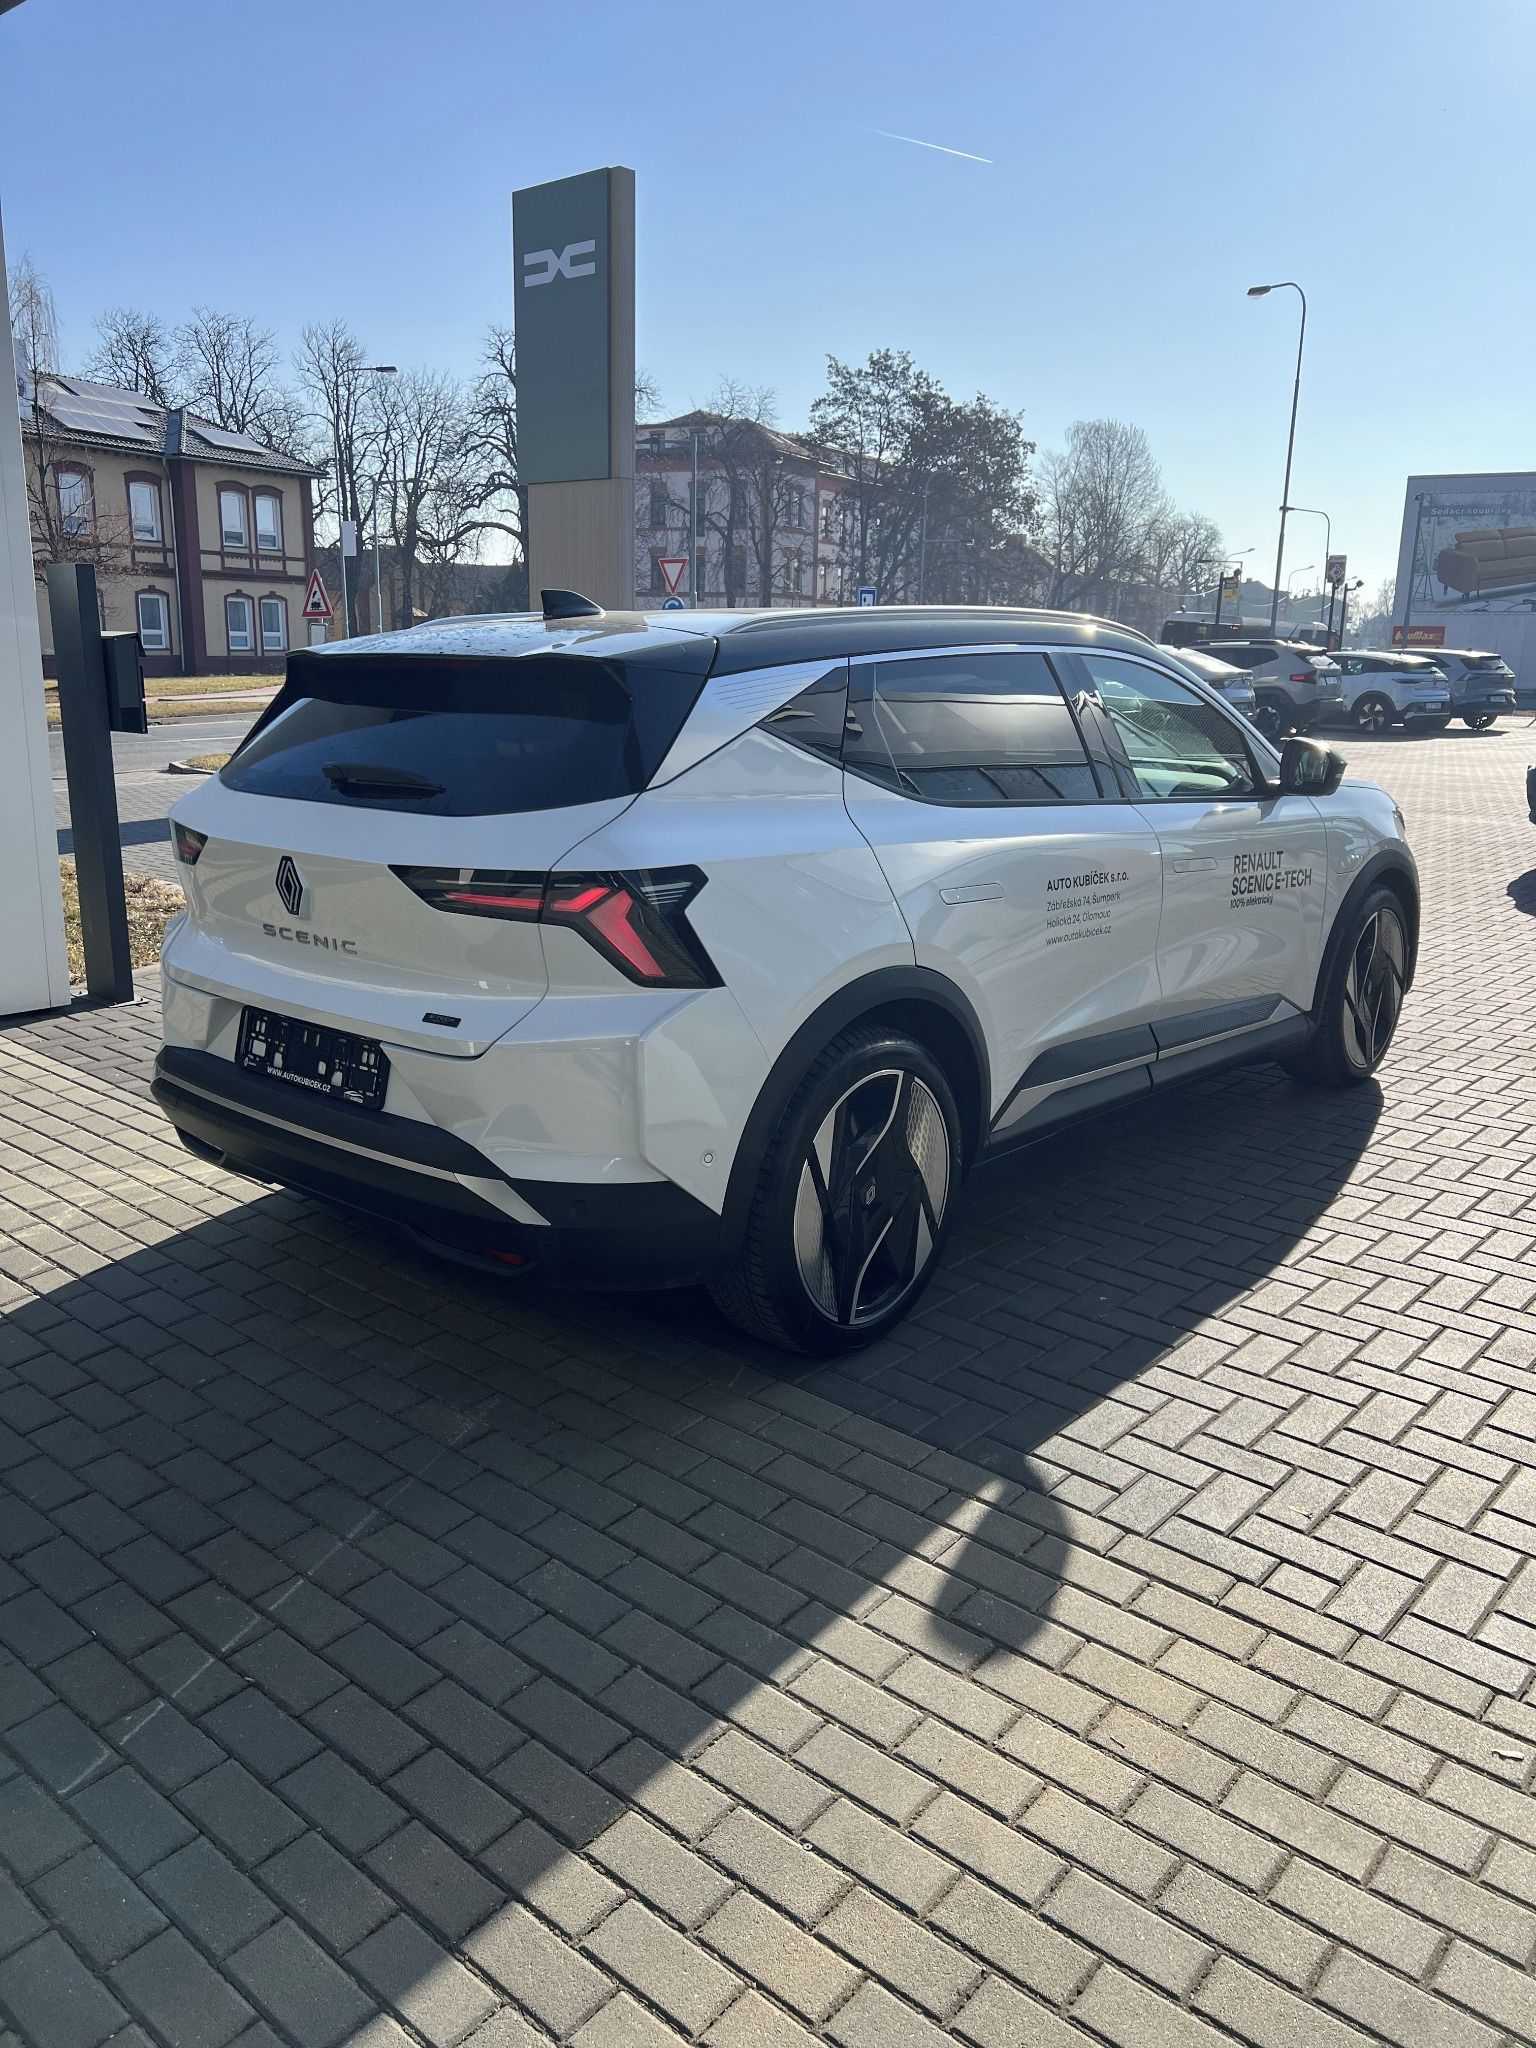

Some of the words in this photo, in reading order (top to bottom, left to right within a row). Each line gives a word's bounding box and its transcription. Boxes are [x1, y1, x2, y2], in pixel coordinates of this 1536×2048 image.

[1233, 851, 1284, 874] RENAULT
[1046, 877, 1072, 892] AUTO
[1072, 870, 1110, 888] KUBÍČEK
[1110, 871, 1129, 882] s.r.o.
[1231, 872, 1274, 896] SCENIC
[1274, 868, 1312, 890] E-TECH
[1092, 891, 1121, 905] Šumperk
[1230, 897, 1246, 909] 100%
[1046, 914, 1072, 929] Holická
[1072, 914, 1082, 925] 24,
[1082, 909, 1112, 922] Olomouc
[262, 923, 358, 956] SCENIC
[1045, 924, 1112, 946] www.autokubicek.cz
[266, 1065, 332, 1093] WWW.AUTOKUBICEK.CZ
